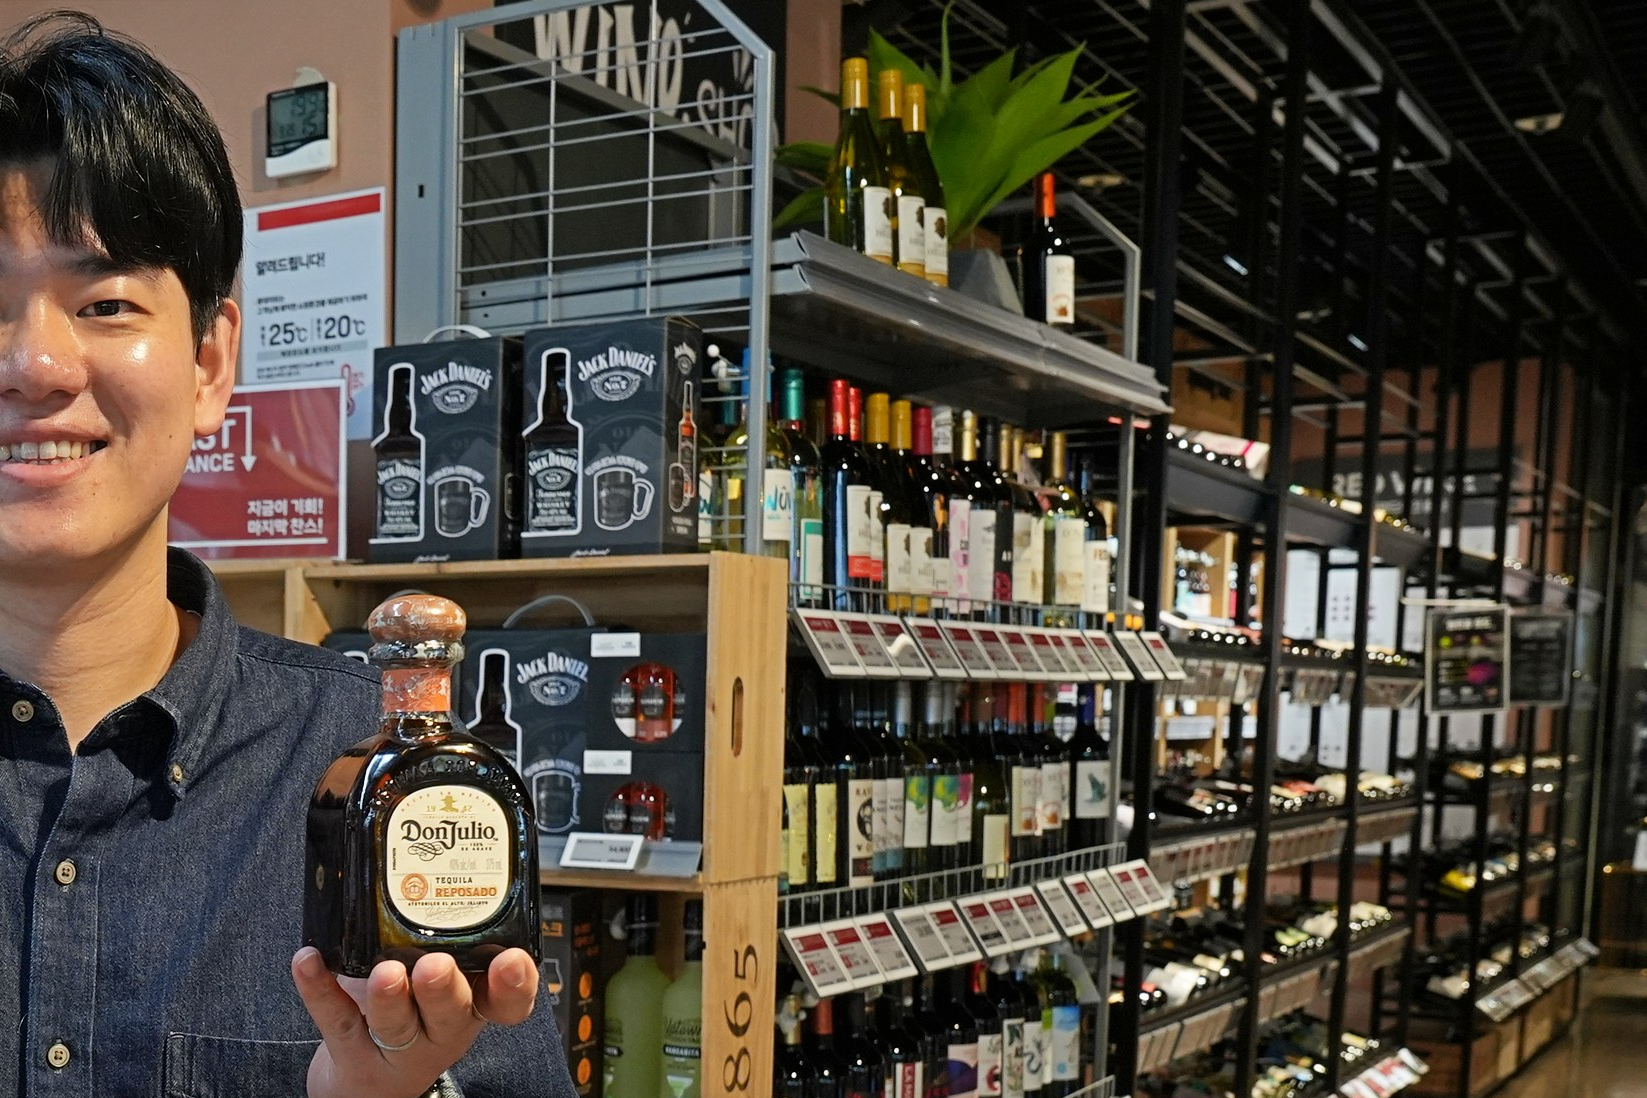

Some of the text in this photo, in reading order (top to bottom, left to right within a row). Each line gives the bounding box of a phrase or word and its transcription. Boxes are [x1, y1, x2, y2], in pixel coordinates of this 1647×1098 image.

[255, 252, 326, 276] 알려드립니다!
[577, 354, 608, 381] JACK
[185, 452, 235, 473] ANCE
[435, 887, 497, 898] REPOSADO
